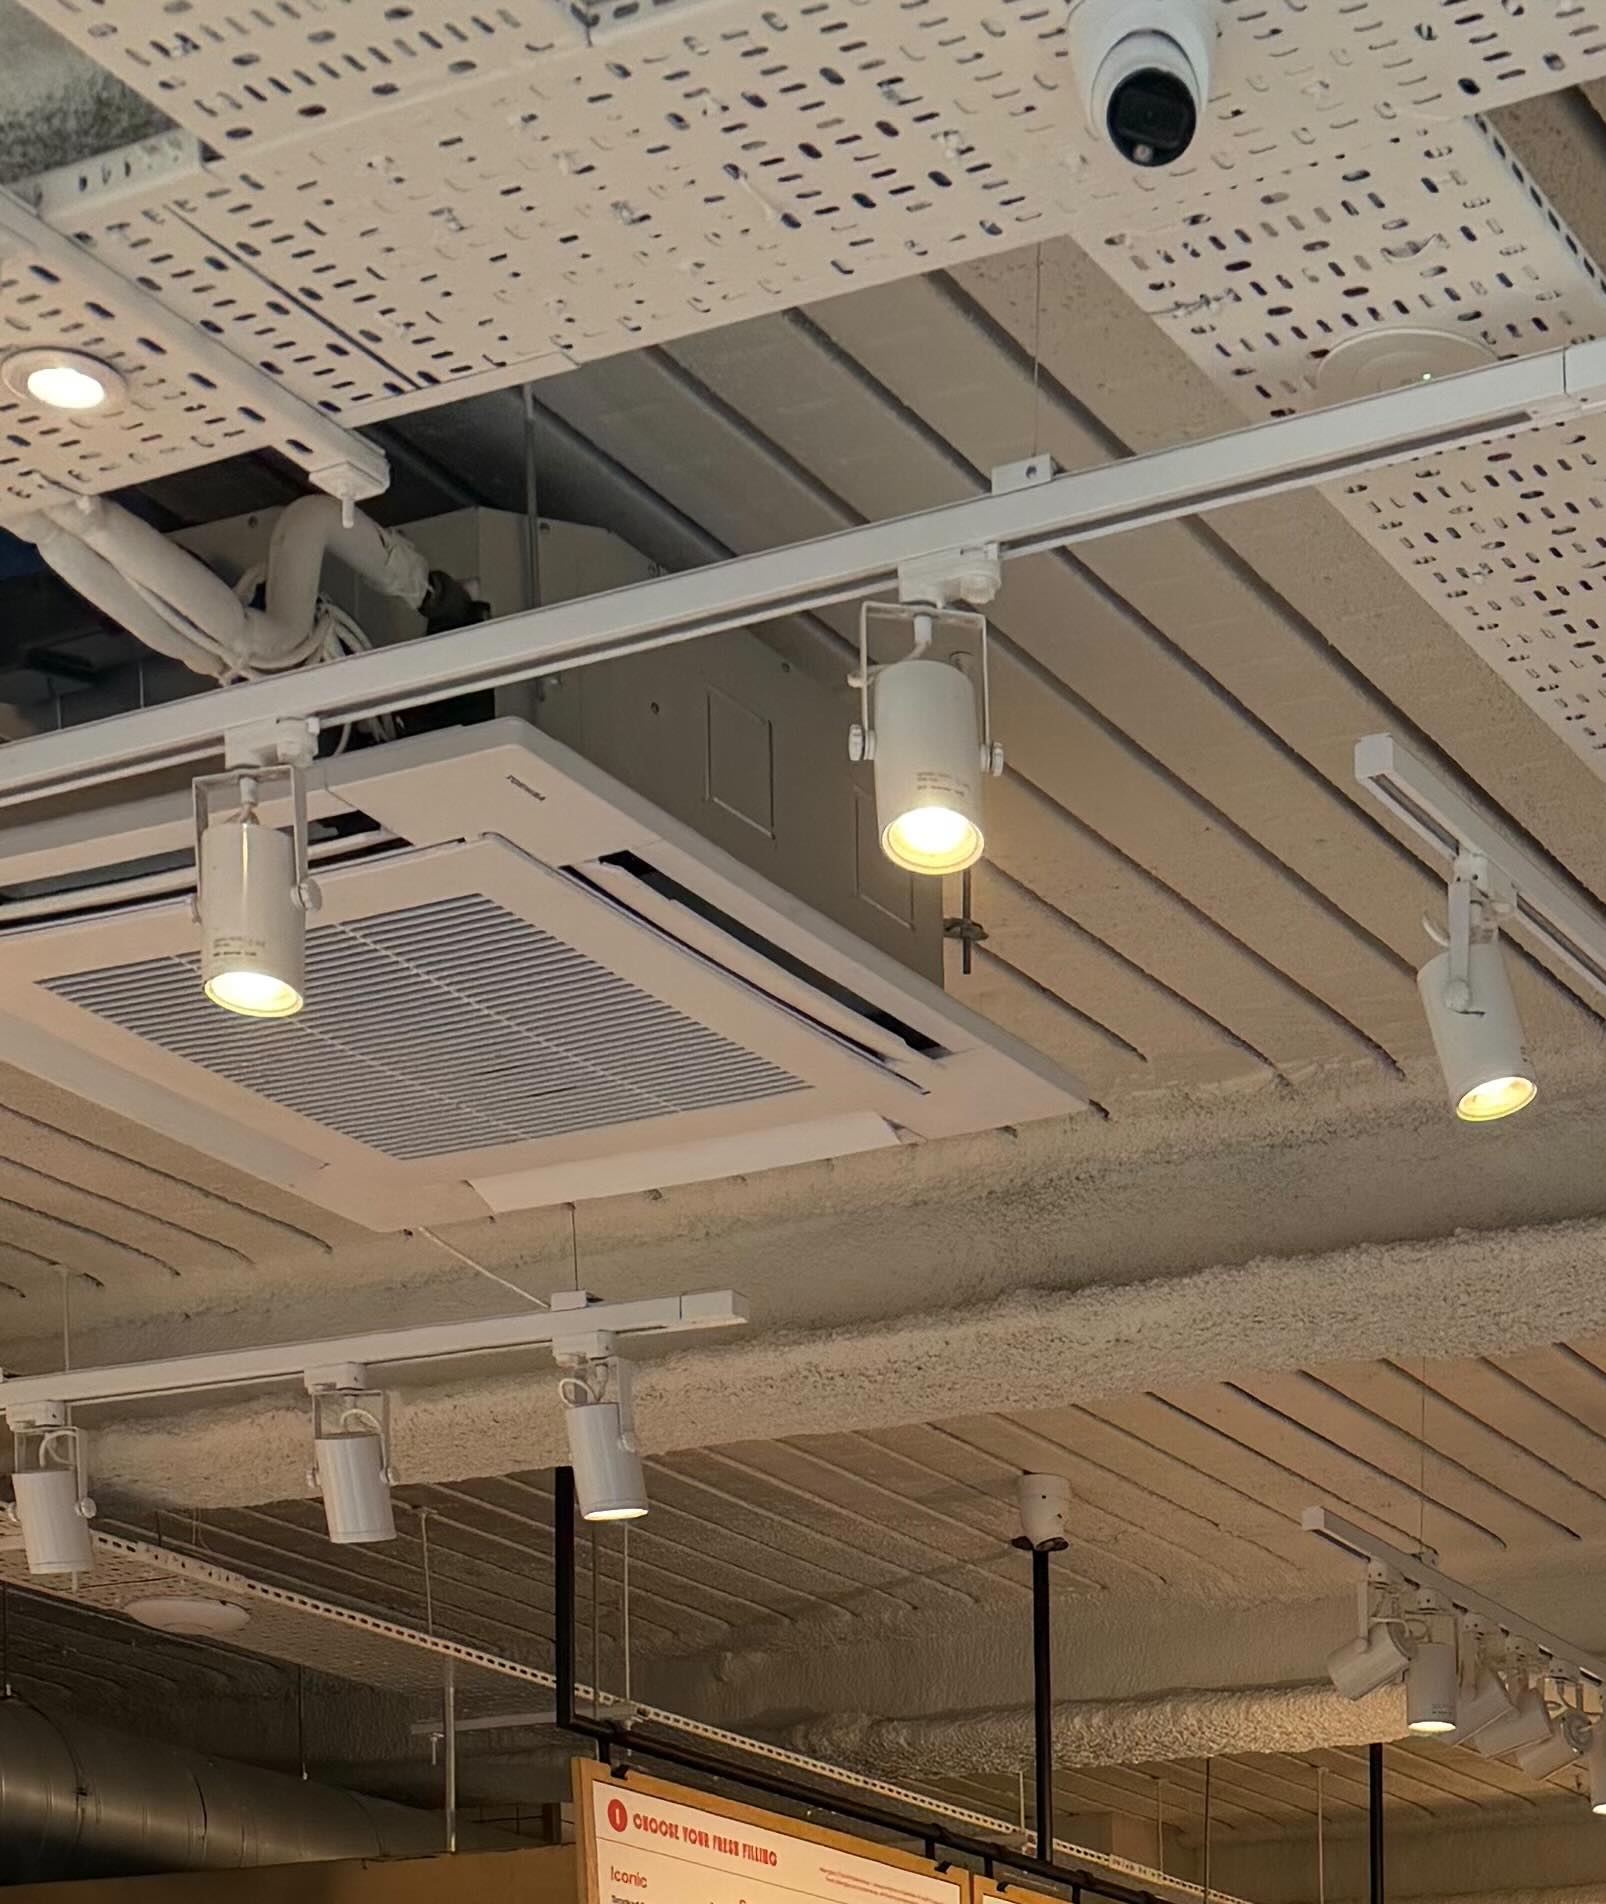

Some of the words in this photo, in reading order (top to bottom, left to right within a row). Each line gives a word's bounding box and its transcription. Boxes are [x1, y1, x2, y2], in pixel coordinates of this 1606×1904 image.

[633, 1813, 680, 1840] CHOOSE
[683, 1826, 709, 1849] YOUR
[712, 1834, 740, 1857] FRESH
[742, 1842, 778, 1867] FILLING
[610, 1865, 648, 1888] Iconic
